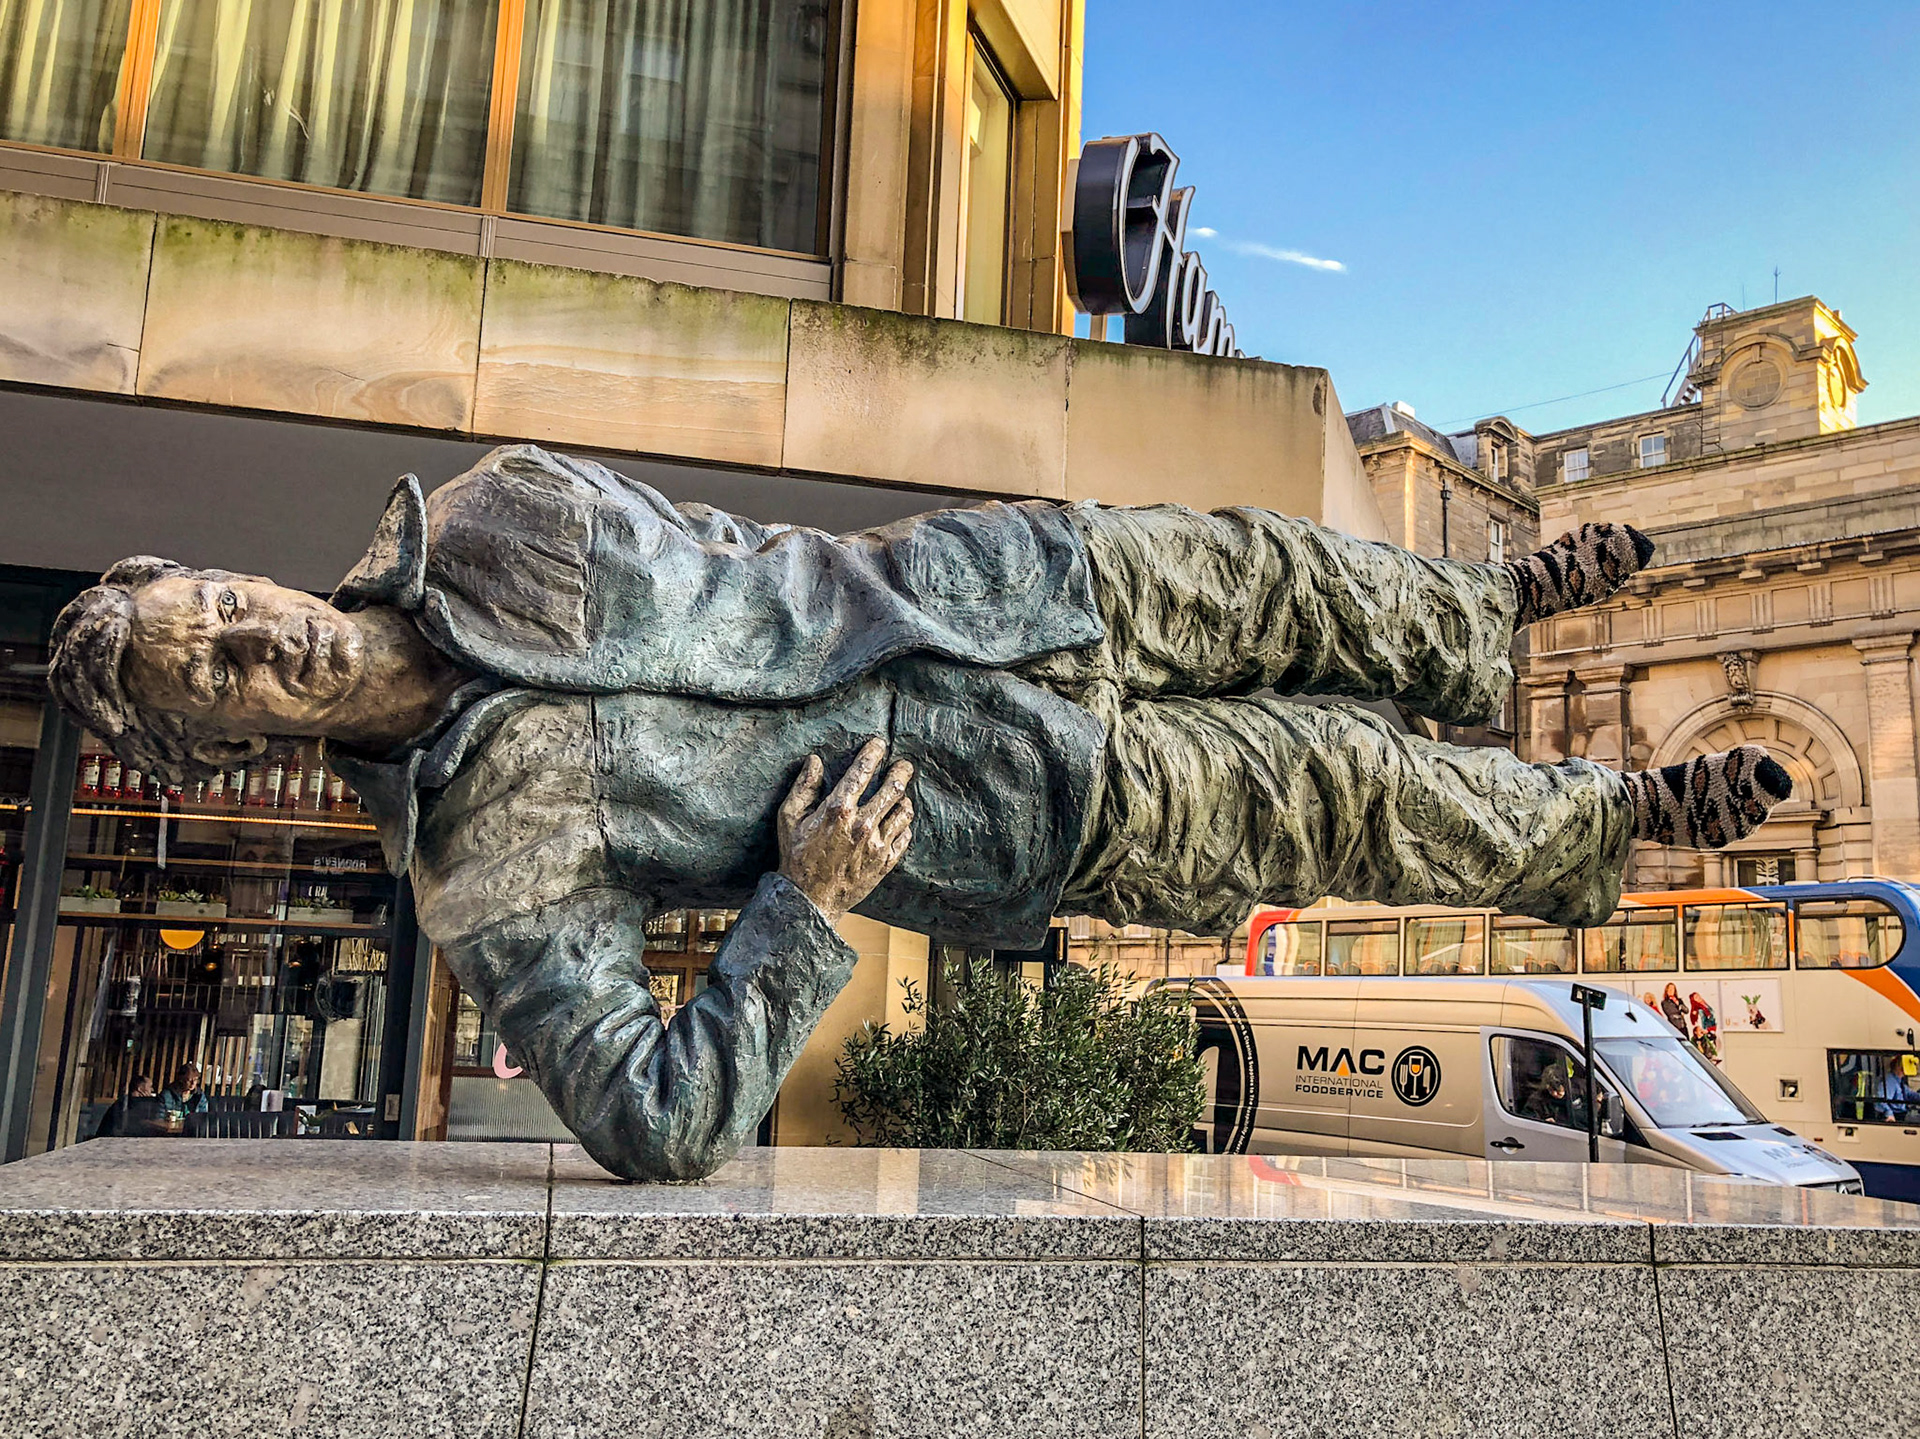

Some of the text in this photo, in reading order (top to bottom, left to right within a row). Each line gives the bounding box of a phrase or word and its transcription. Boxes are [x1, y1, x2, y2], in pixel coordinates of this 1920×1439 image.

[1297, 1046, 1385, 1076] MAC
[1296, 1075, 1384, 1089] INTERNATIONAL
[1295, 1085, 1384, 1098] FOODSERVICE
